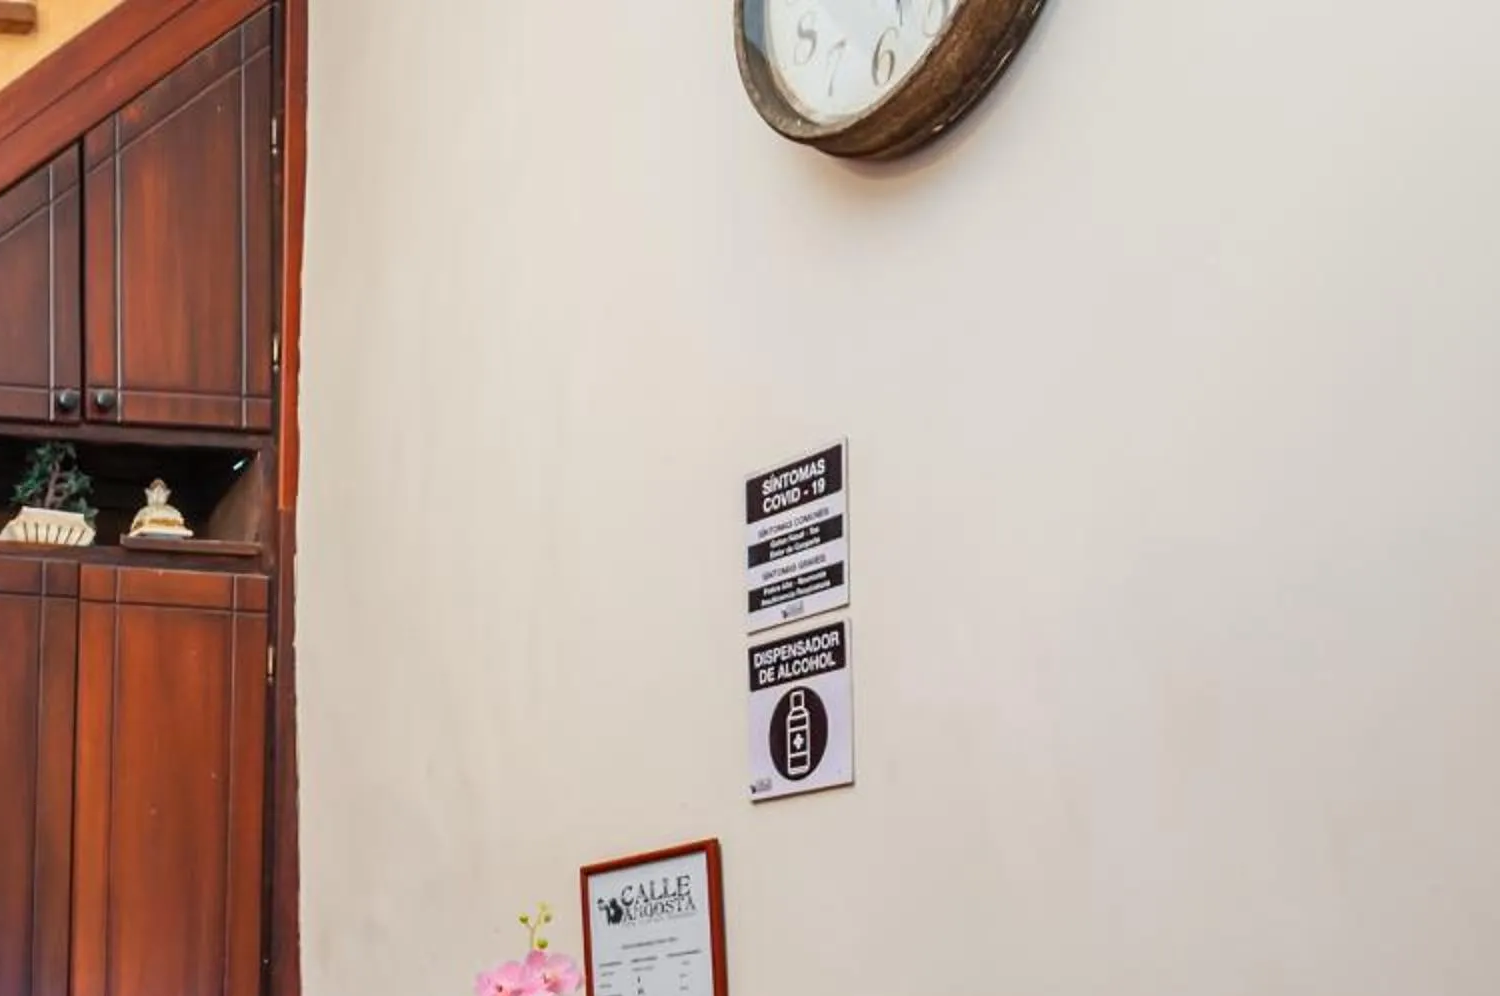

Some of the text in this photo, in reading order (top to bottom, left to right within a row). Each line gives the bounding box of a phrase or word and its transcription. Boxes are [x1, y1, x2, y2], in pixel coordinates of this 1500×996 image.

[793, 11, 818, 66] 8
[872, 26, 899, 87] 6
[825, 37, 847, 97] 7
[763, 487, 801, 513] COVID
[812, 477, 826, 495] 19
[754, 631, 839, 668] DISPENSADOR
[759, 651, 837, 685] DE ALCOHOL
[621, 875, 691, 906] CALLE
